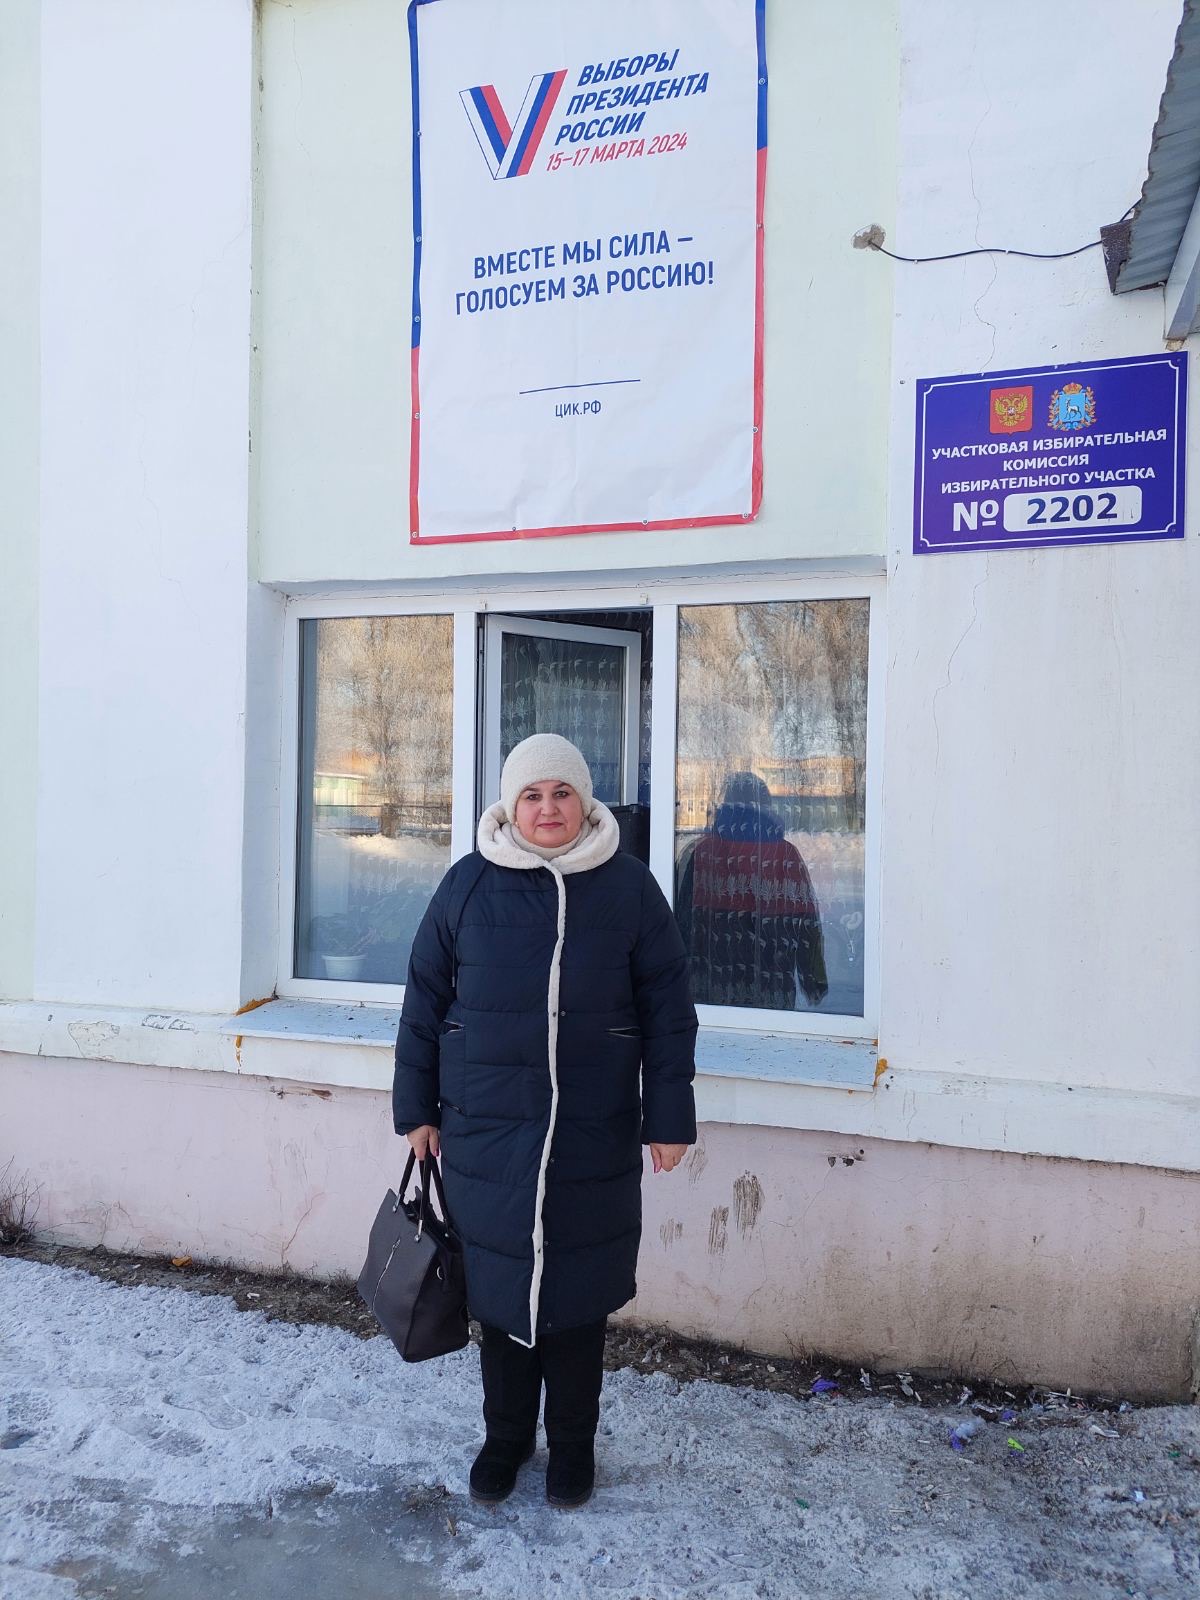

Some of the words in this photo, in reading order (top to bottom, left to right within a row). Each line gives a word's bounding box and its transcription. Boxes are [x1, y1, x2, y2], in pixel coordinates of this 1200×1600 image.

[577, 49, 680, 87] ВЫБОРЫ
[566, 72, 710, 116] ПРЕЗИДЕНТА
[555, 111, 646, 146] РОССИИ
[590, 138, 646, 164] МАРТА
[647, 132, 688, 155] 2024
[474, 245, 555, 279] ВМЕСТЕ
[563, 238, 602, 266] МЫ
[609, 230, 671, 259] СИЛА
[455, 277, 565, 316] ГОЛОСУЕМ
[572, 273, 599, 298] ЗА
[607, 261, 714, 294] РОССИЮ!
[555, 400, 602, 418] ЦИК.РФ
[932, 440, 1028, 460] УЧАСТКОВАЯ
[1033, 428, 1167, 451] ИЗБИРАТЕЛЬНАЯ
[1003, 453, 1089, 472] КОМИССИЯ
[941, 472, 1080, 494] ИЗБИРАТЕЛЬНОГО
[1084, 467, 1156, 484] УЧАСТКА
[1026, 492, 1118, 525] 2202
